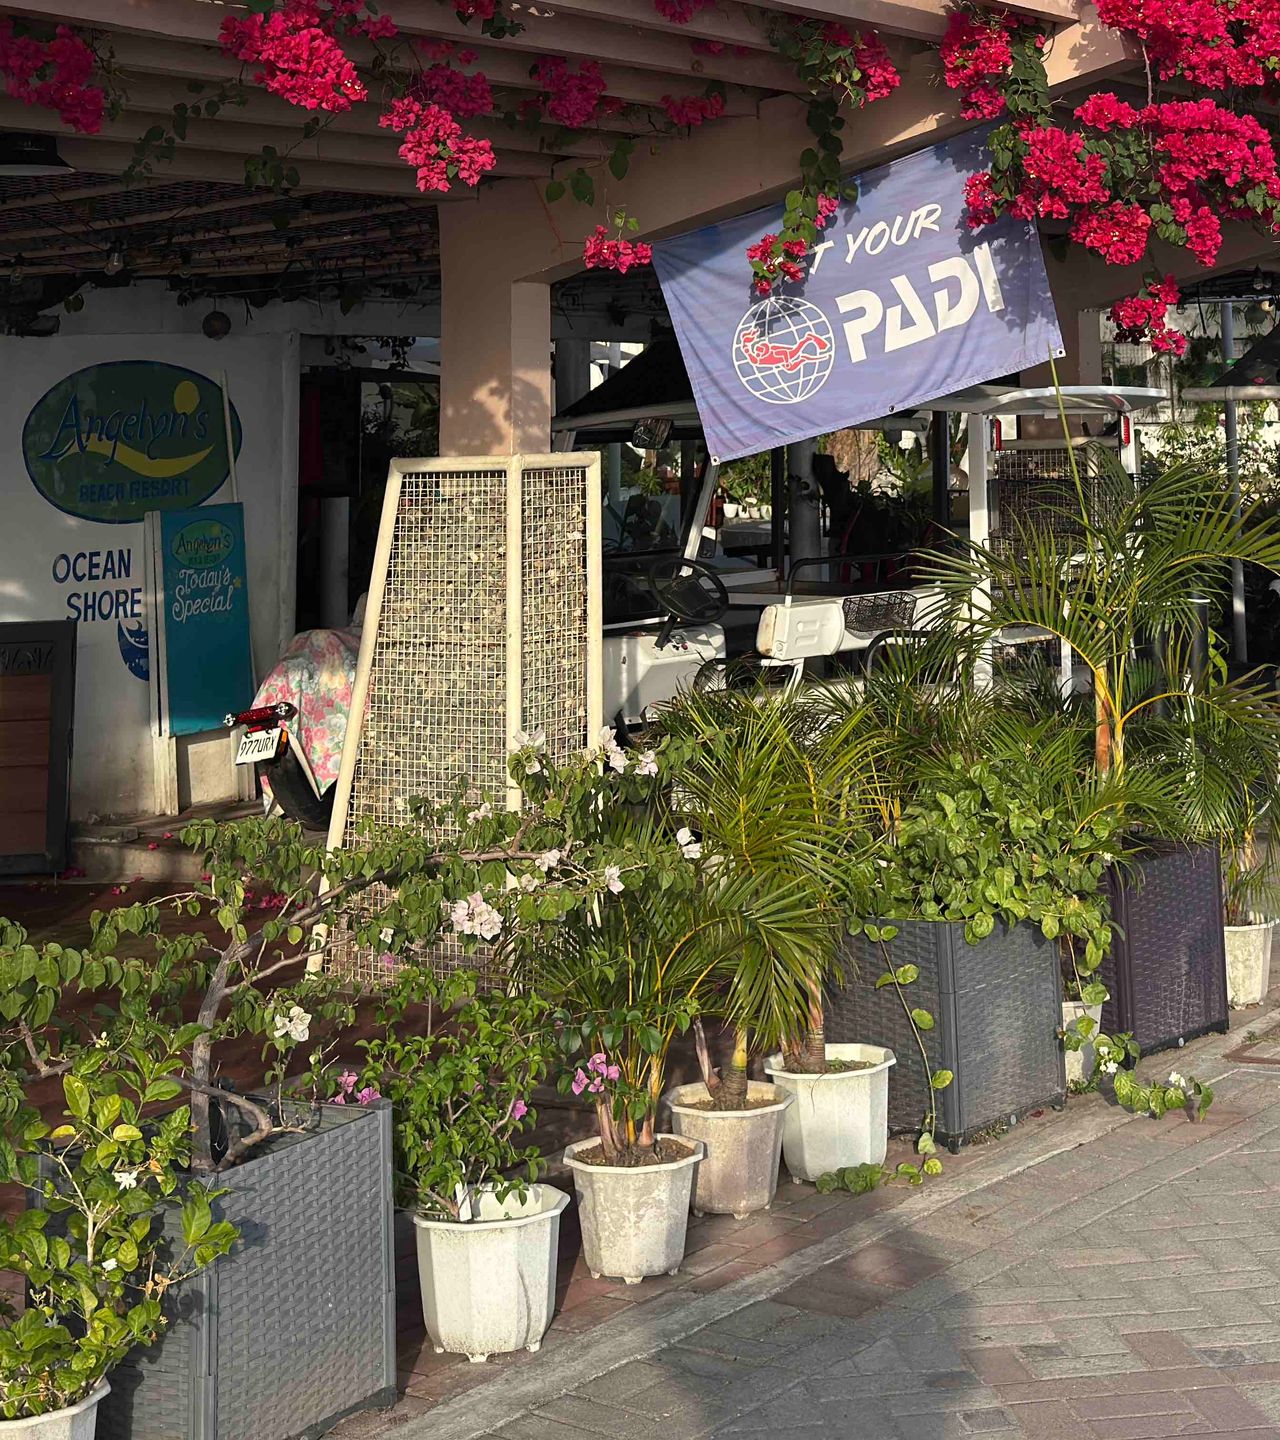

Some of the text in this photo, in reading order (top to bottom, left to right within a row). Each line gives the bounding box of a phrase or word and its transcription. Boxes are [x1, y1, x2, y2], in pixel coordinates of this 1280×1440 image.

[843, 202, 942, 265] YOUR
[834, 241, 1006, 364] PADI
[37, 391, 211, 466] Angelyn's
[128, 478, 191, 499] RESORT
[52, 548, 132, 584] OCEAN
[178, 564, 232, 594] Today's
[66, 587, 142, 622] SHORE
[171, 585, 234, 625] Special
[239, 735, 277, 757] 977URX
